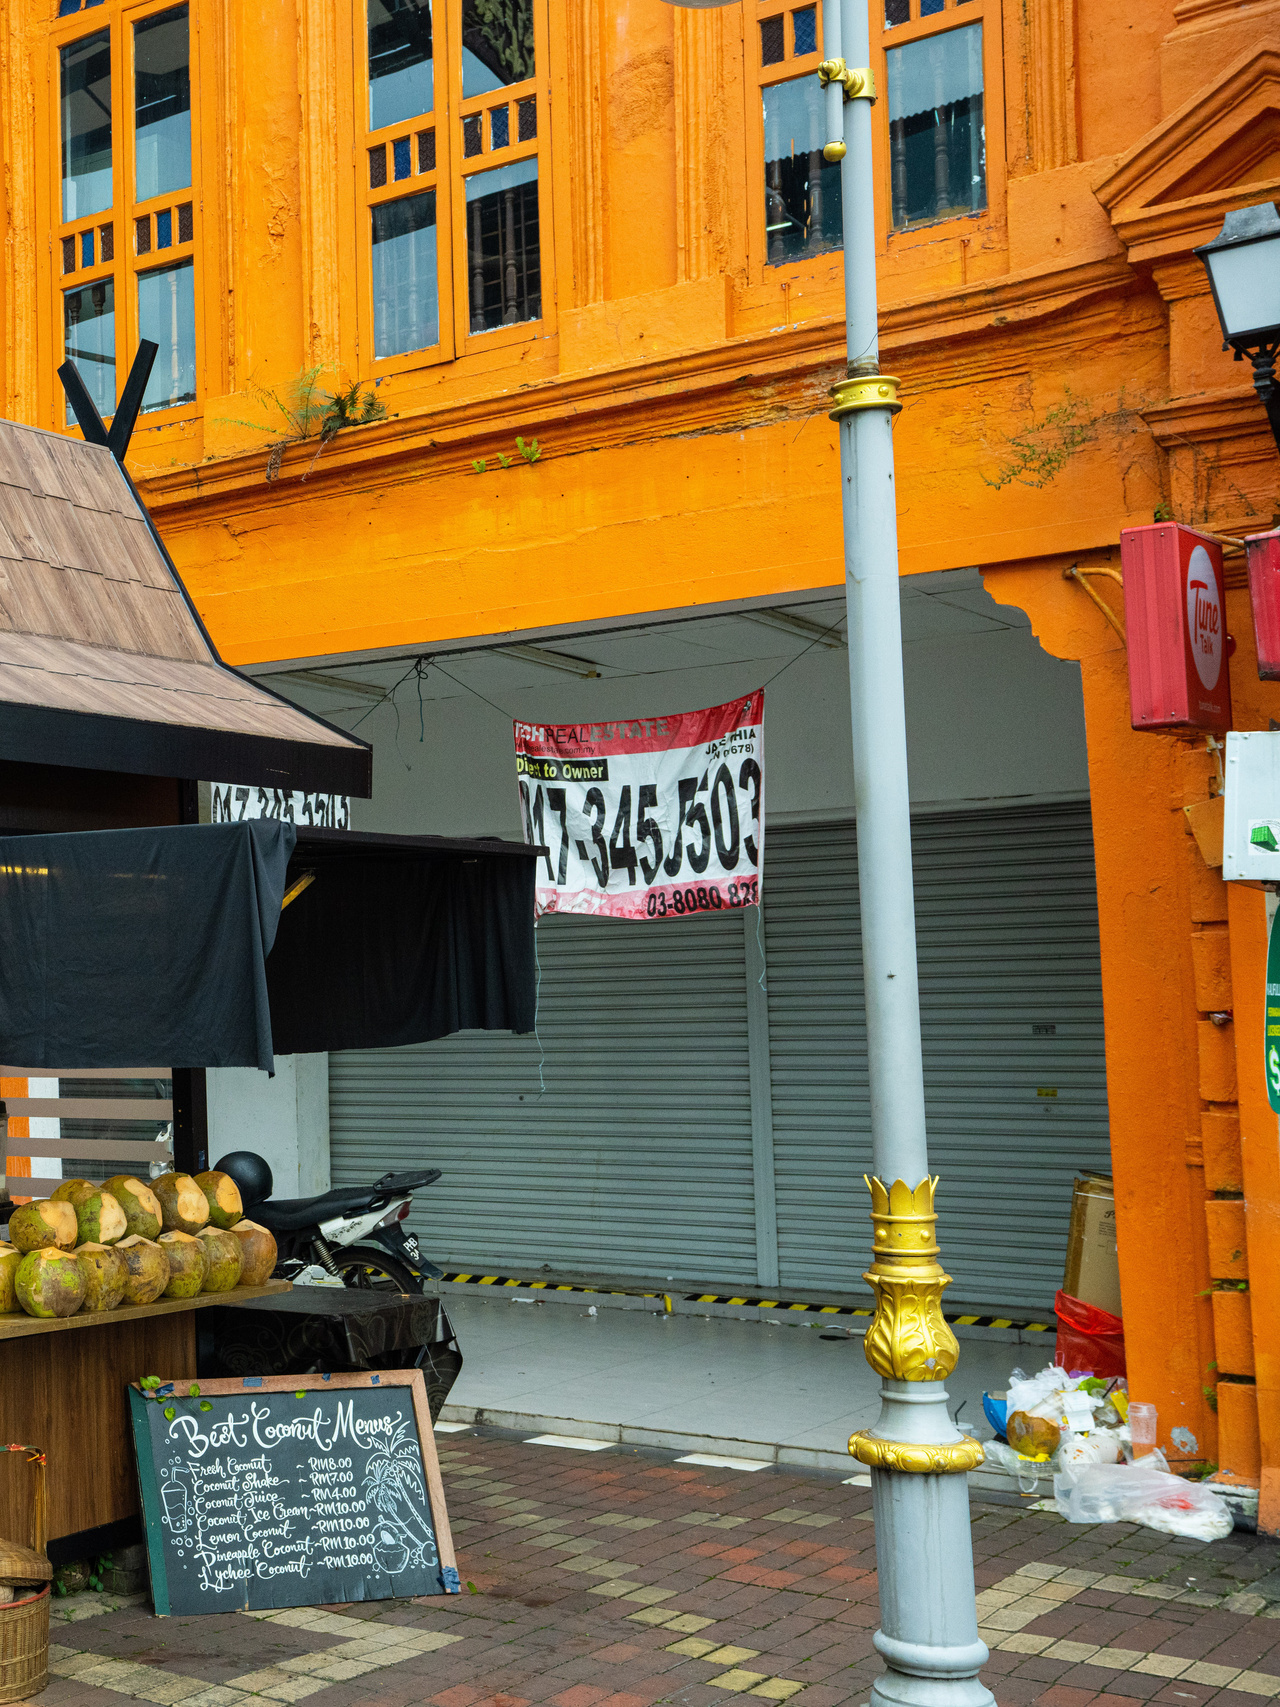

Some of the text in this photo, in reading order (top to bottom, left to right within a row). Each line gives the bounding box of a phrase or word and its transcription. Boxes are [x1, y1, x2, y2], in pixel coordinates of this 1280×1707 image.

[1190, 580, 1220, 644] Tune
[1200, 634, 1214, 656] Talk
[543, 763, 557, 778] to
[562, 763, 604, 779] Owner
[647, 886, 721, 918] 03-8080
[170, 1399, 403, 1458] Best Coconut Menus
[187, 1454, 352, 1481] Fresh Coconut RM8.00
[192, 1471, 354, 1496] Coconut Shake RM7.00
[193, 1486, 357, 1515] Coconut Juice RM4.00
[196, 1511, 247, 1532] Coconut
[248, 1506, 271, 1525] Ice
[271, 1501, 311, 1521] Cream
[195, 1530, 242, 1551] Lemon
[241, 1520, 296, 1542] Coconut
[193, 1543, 261, 1576] Pineapple
[262, 1536, 315, 1559] Coconut
[198, 1564, 254, 1593] Lychee
[254, 1555, 313, 1580] Coconut
